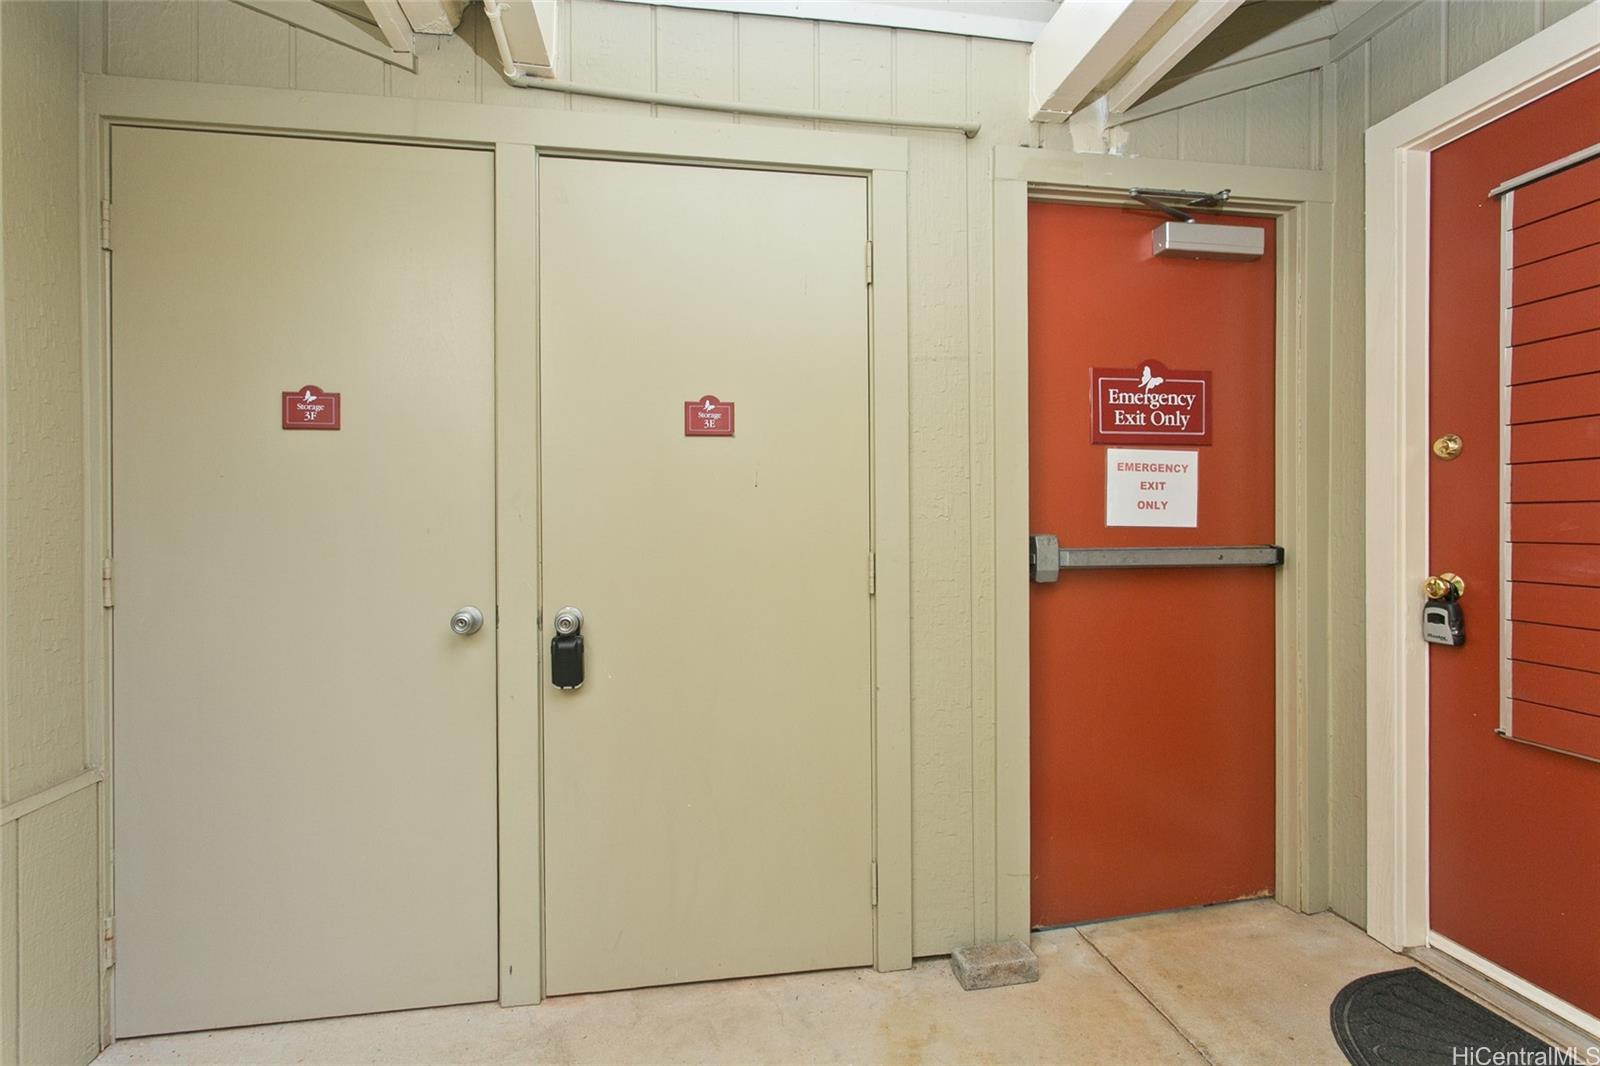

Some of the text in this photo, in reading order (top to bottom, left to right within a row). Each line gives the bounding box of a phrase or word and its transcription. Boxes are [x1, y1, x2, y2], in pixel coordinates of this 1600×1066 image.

[1108, 388, 1196, 410] Emergency
[297, 403, 325, 411] Storage
[304, 411, 318, 421] 3F
[698, 411, 721, 420] Storage
[1114, 410, 1191, 431] Exit Only
[703, 419, 716, 429] 3E
[1116, 462, 1189, 473] EMERGENCY
[1140, 481, 1166, 491] EXIT
[1137, 500, 1169, 510] ONLY
